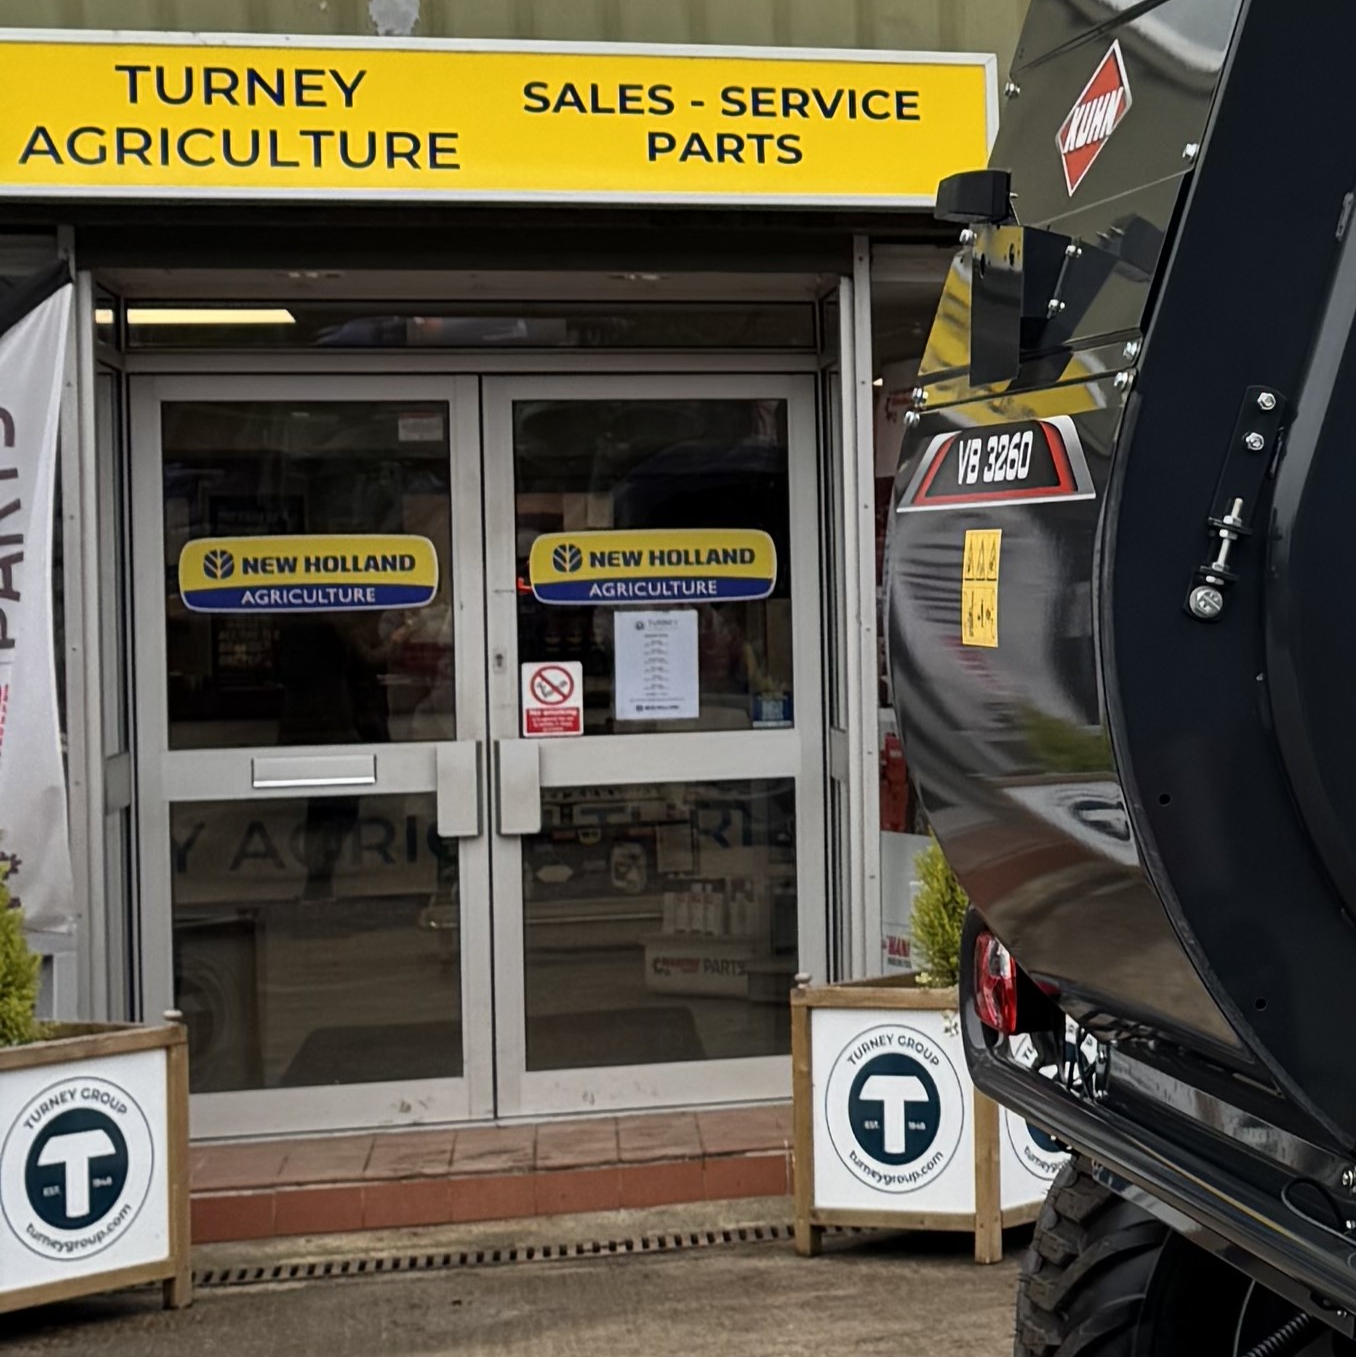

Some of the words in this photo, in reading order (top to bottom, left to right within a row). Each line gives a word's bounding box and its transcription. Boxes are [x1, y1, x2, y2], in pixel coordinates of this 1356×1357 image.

[114, 64, 368, 108] TURNEY
[522, 80, 674, 117] SALES
[720, 84, 922, 122] SERVICE
[1062, 86, 1125, 154] KUHN
[18, 125, 461, 171] AGRICULTURE
[646, 132, 804, 166] PARTS
[957, 437, 982, 485] VB
[983, 430, 1034, 483] 3260
[241, 555, 298, 575] NEW
[303, 553, 416, 574] HOLLAND
[589, 550, 644, 568] NEW
[649, 547, 756, 566] HOLLAND
[240, 587, 376, 605] AGRICULTURE
[588, 580, 718, 598] AGRICULTURE
[845, 1033, 895, 1066] TURNEY
[897, 1035, 941, 1067] GROUP
[23, 1087, 78, 1130] TURNEY
[80, 1086, 128, 1116] GROUP
[849, 1149, 945, 1186] turneygroup.com
[25, 1202, 132, 1253] turneygroup.com
